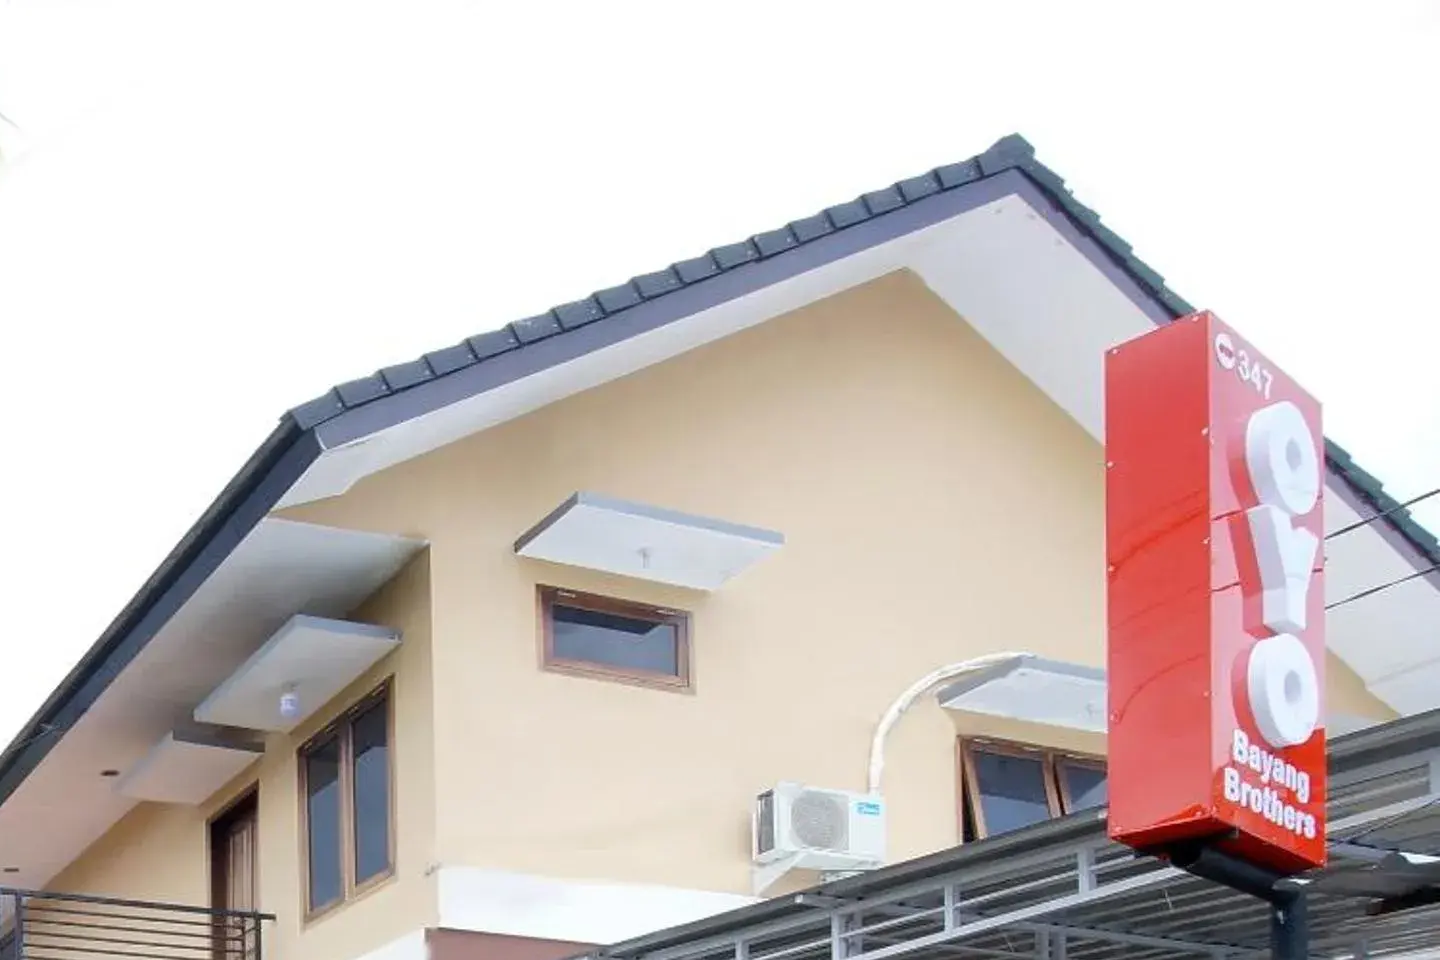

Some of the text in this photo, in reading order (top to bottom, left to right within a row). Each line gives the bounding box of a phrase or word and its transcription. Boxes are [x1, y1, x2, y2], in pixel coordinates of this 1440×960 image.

[1238, 349, 1273, 400] 347
[1233, 729, 1310, 804] Bayang
[1224, 767, 1317, 839] Brothers
